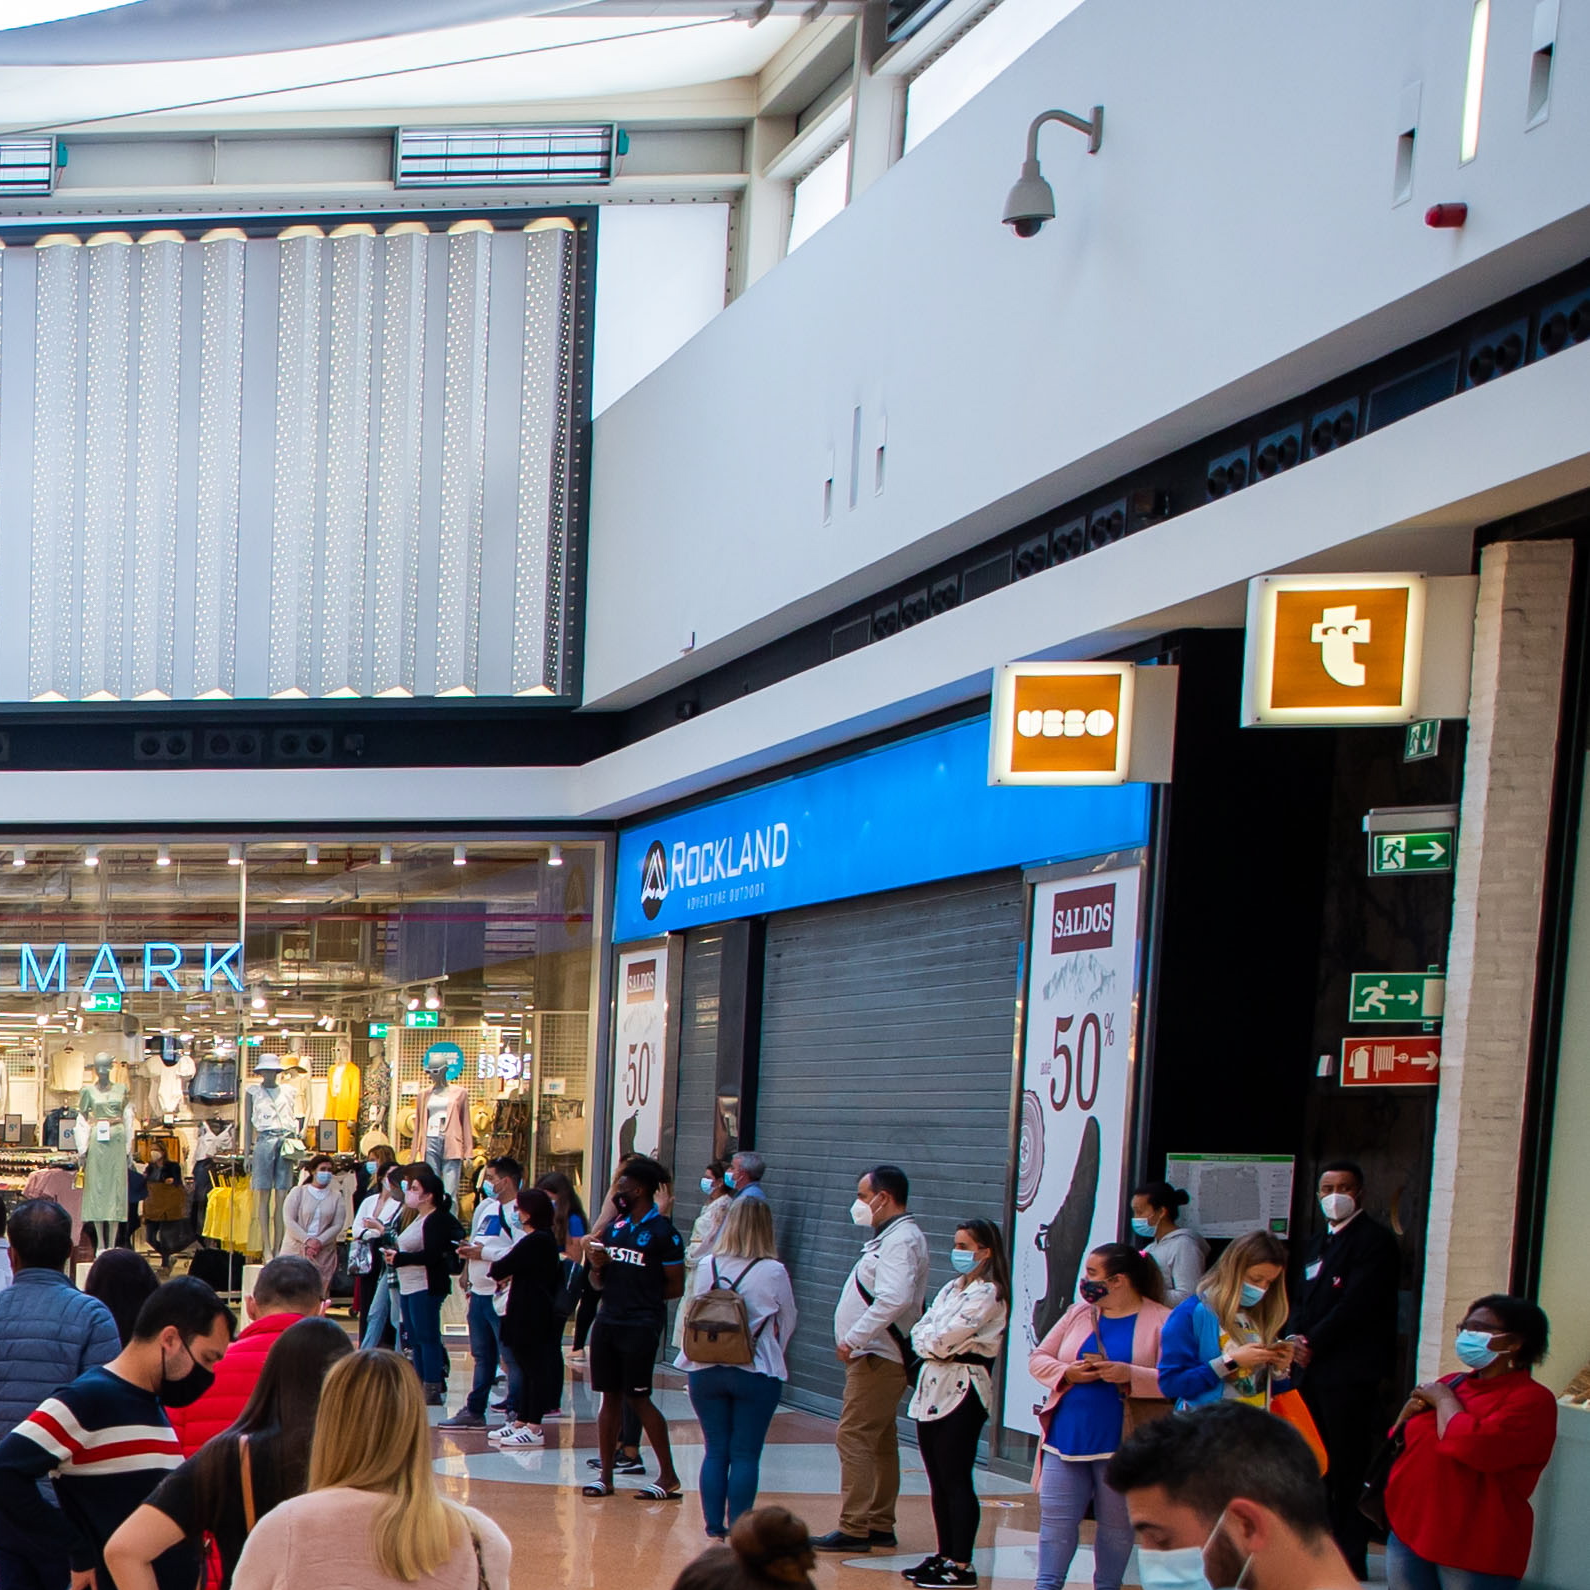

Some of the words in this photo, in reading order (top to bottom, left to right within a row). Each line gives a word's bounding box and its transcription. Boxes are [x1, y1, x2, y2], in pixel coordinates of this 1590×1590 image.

[671, 822, 789, 891] ROCKLAND
[729, 882, 765, 902] OUTDOOR
[1054, 903, 1113, 938] SALDOS
[628, 971, 654, 993] SALDOS
